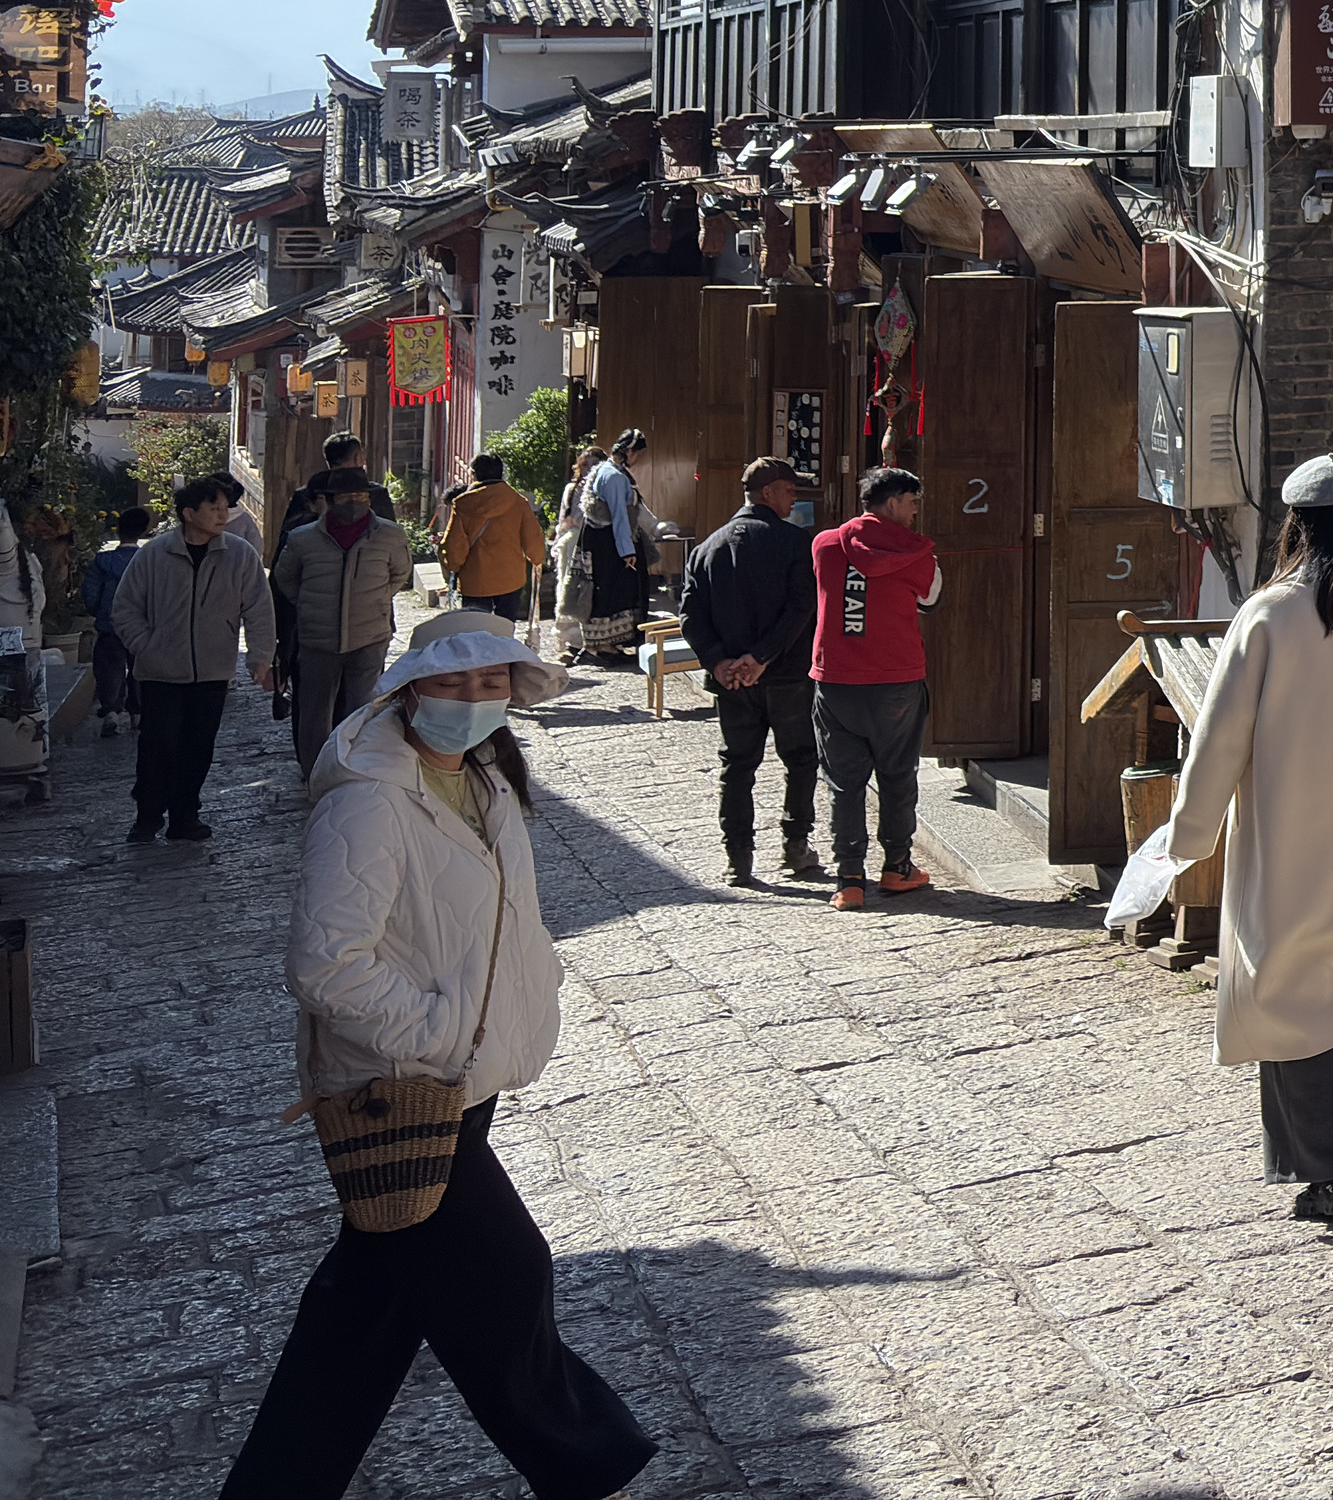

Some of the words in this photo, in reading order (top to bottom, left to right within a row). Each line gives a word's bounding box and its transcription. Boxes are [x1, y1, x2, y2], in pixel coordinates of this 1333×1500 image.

[14, 79, 56, 93] Bar
[396, 87, 422, 130] 喝茶
[962, 477, 989, 515] 2
[1106, 544, 1133, 580] 5
[844, 595, 865, 633] AIR
